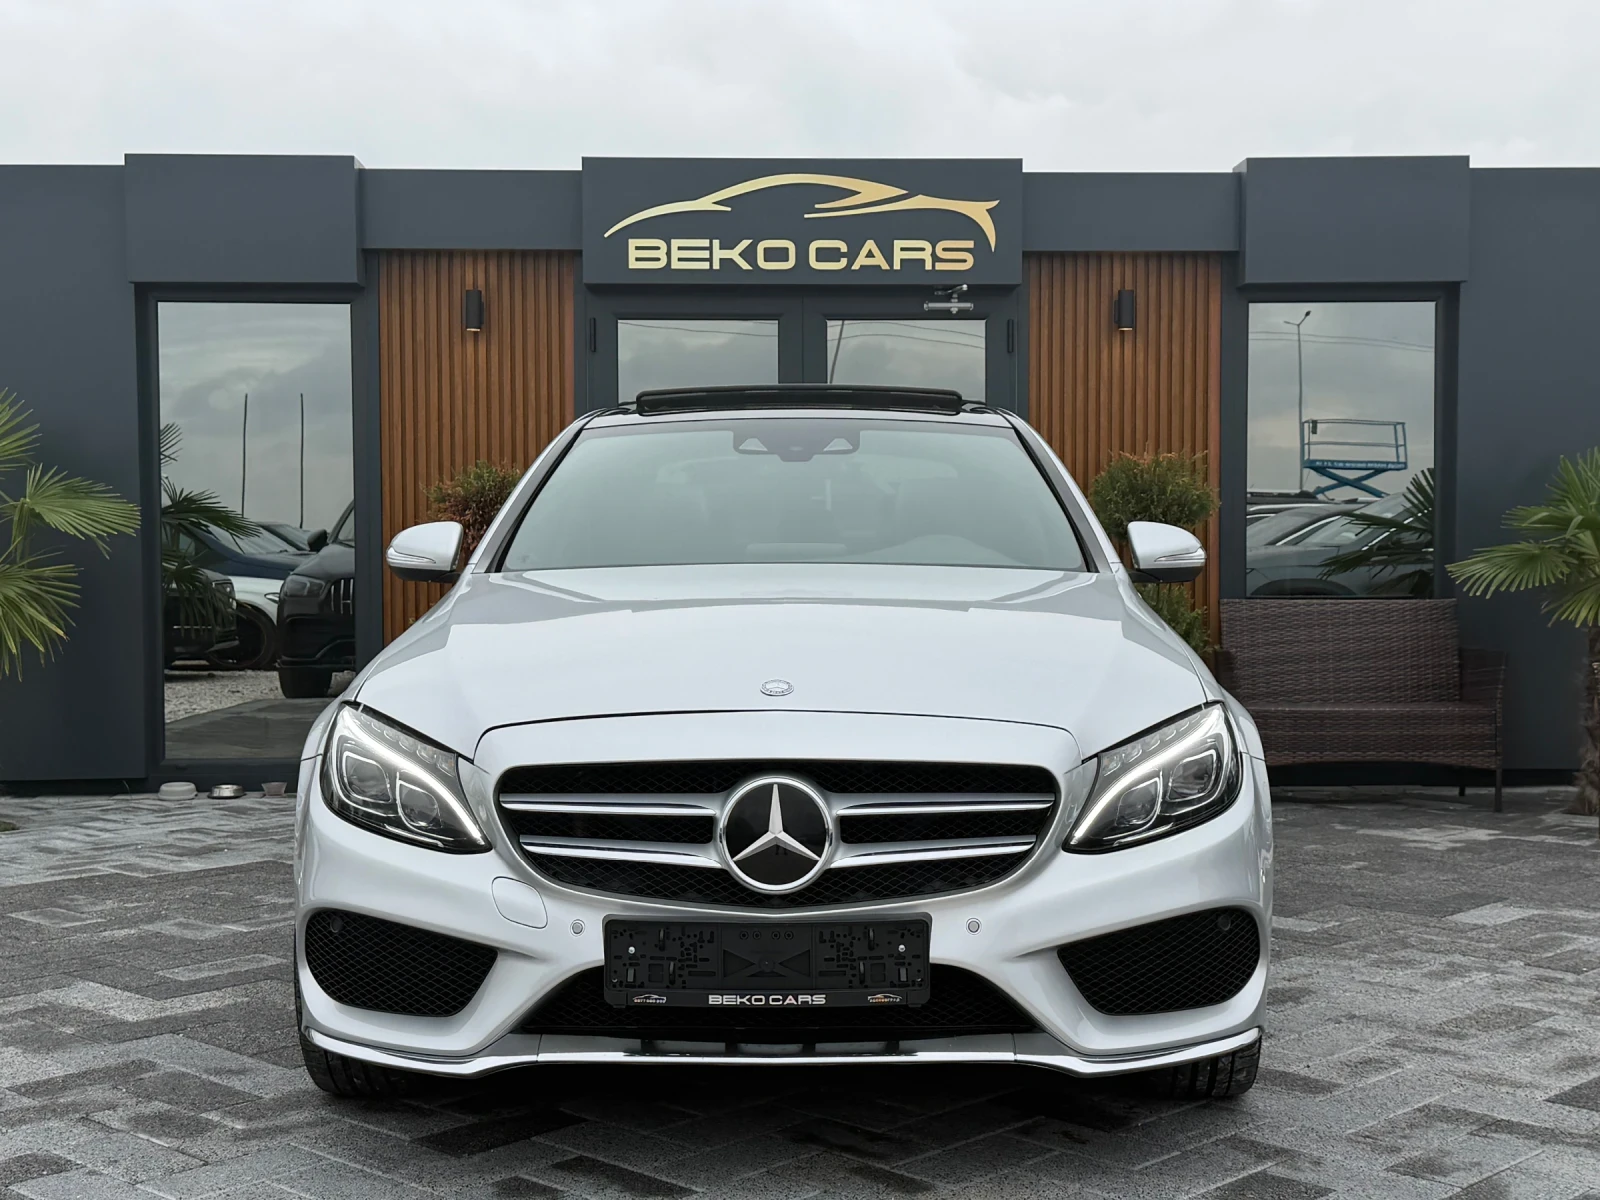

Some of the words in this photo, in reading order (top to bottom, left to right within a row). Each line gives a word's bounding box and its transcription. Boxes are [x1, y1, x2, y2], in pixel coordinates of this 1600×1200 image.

[628, 238, 796, 271] BEKO
[808, 239, 975, 271] CARS
[708, 994, 766, 1005] BEKO
[769, 994, 827, 1005] CARS
